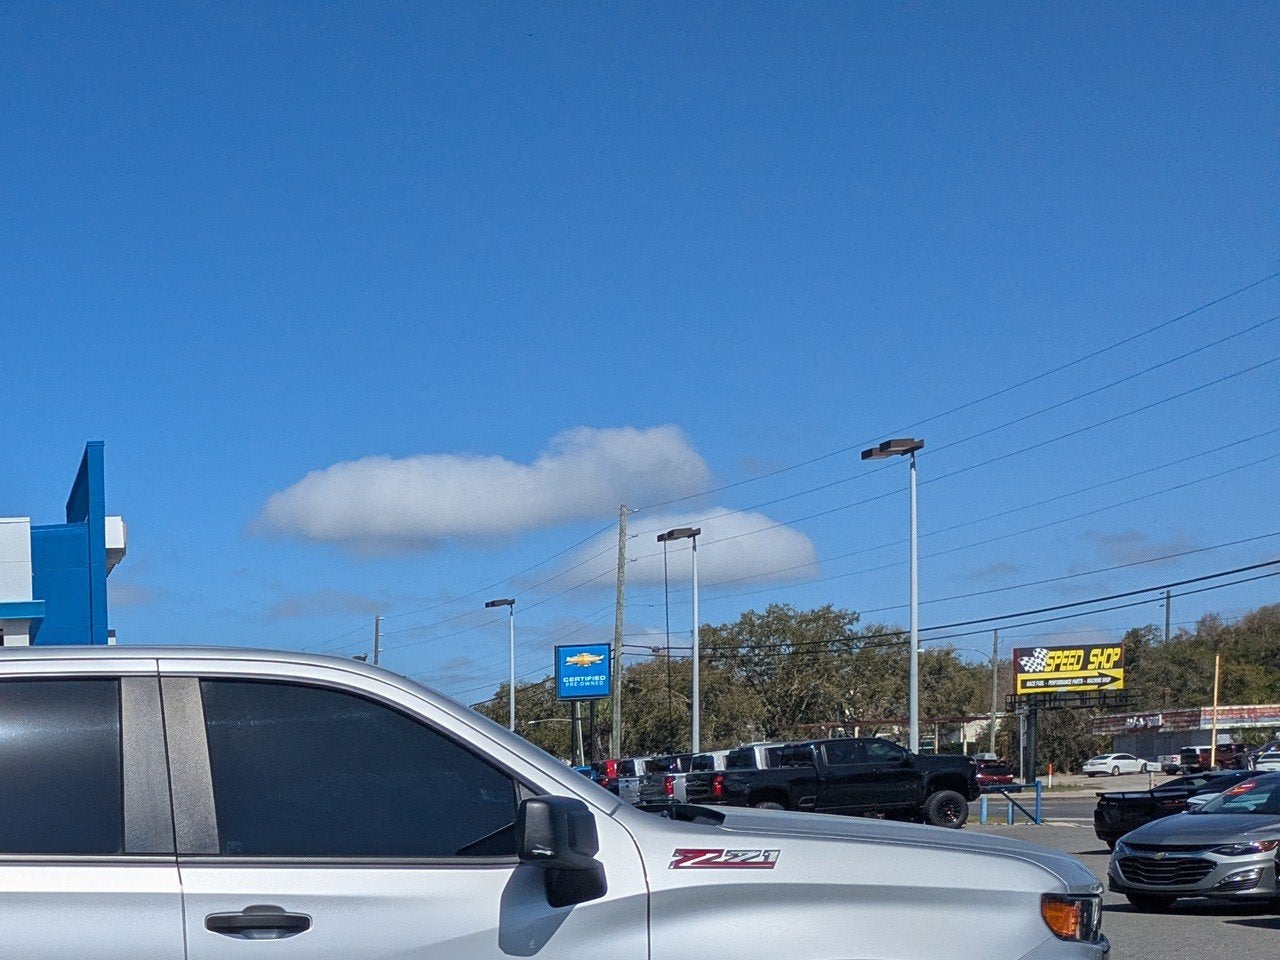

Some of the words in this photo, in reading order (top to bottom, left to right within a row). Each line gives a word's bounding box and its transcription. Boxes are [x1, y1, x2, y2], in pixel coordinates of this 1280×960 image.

[1043, 649, 1085, 672] SPEED
[1087, 647, 1122, 670] SHOP
[563, 675, 606, 683] CERTIFIED
[668, 848, 781, 870] Z71
